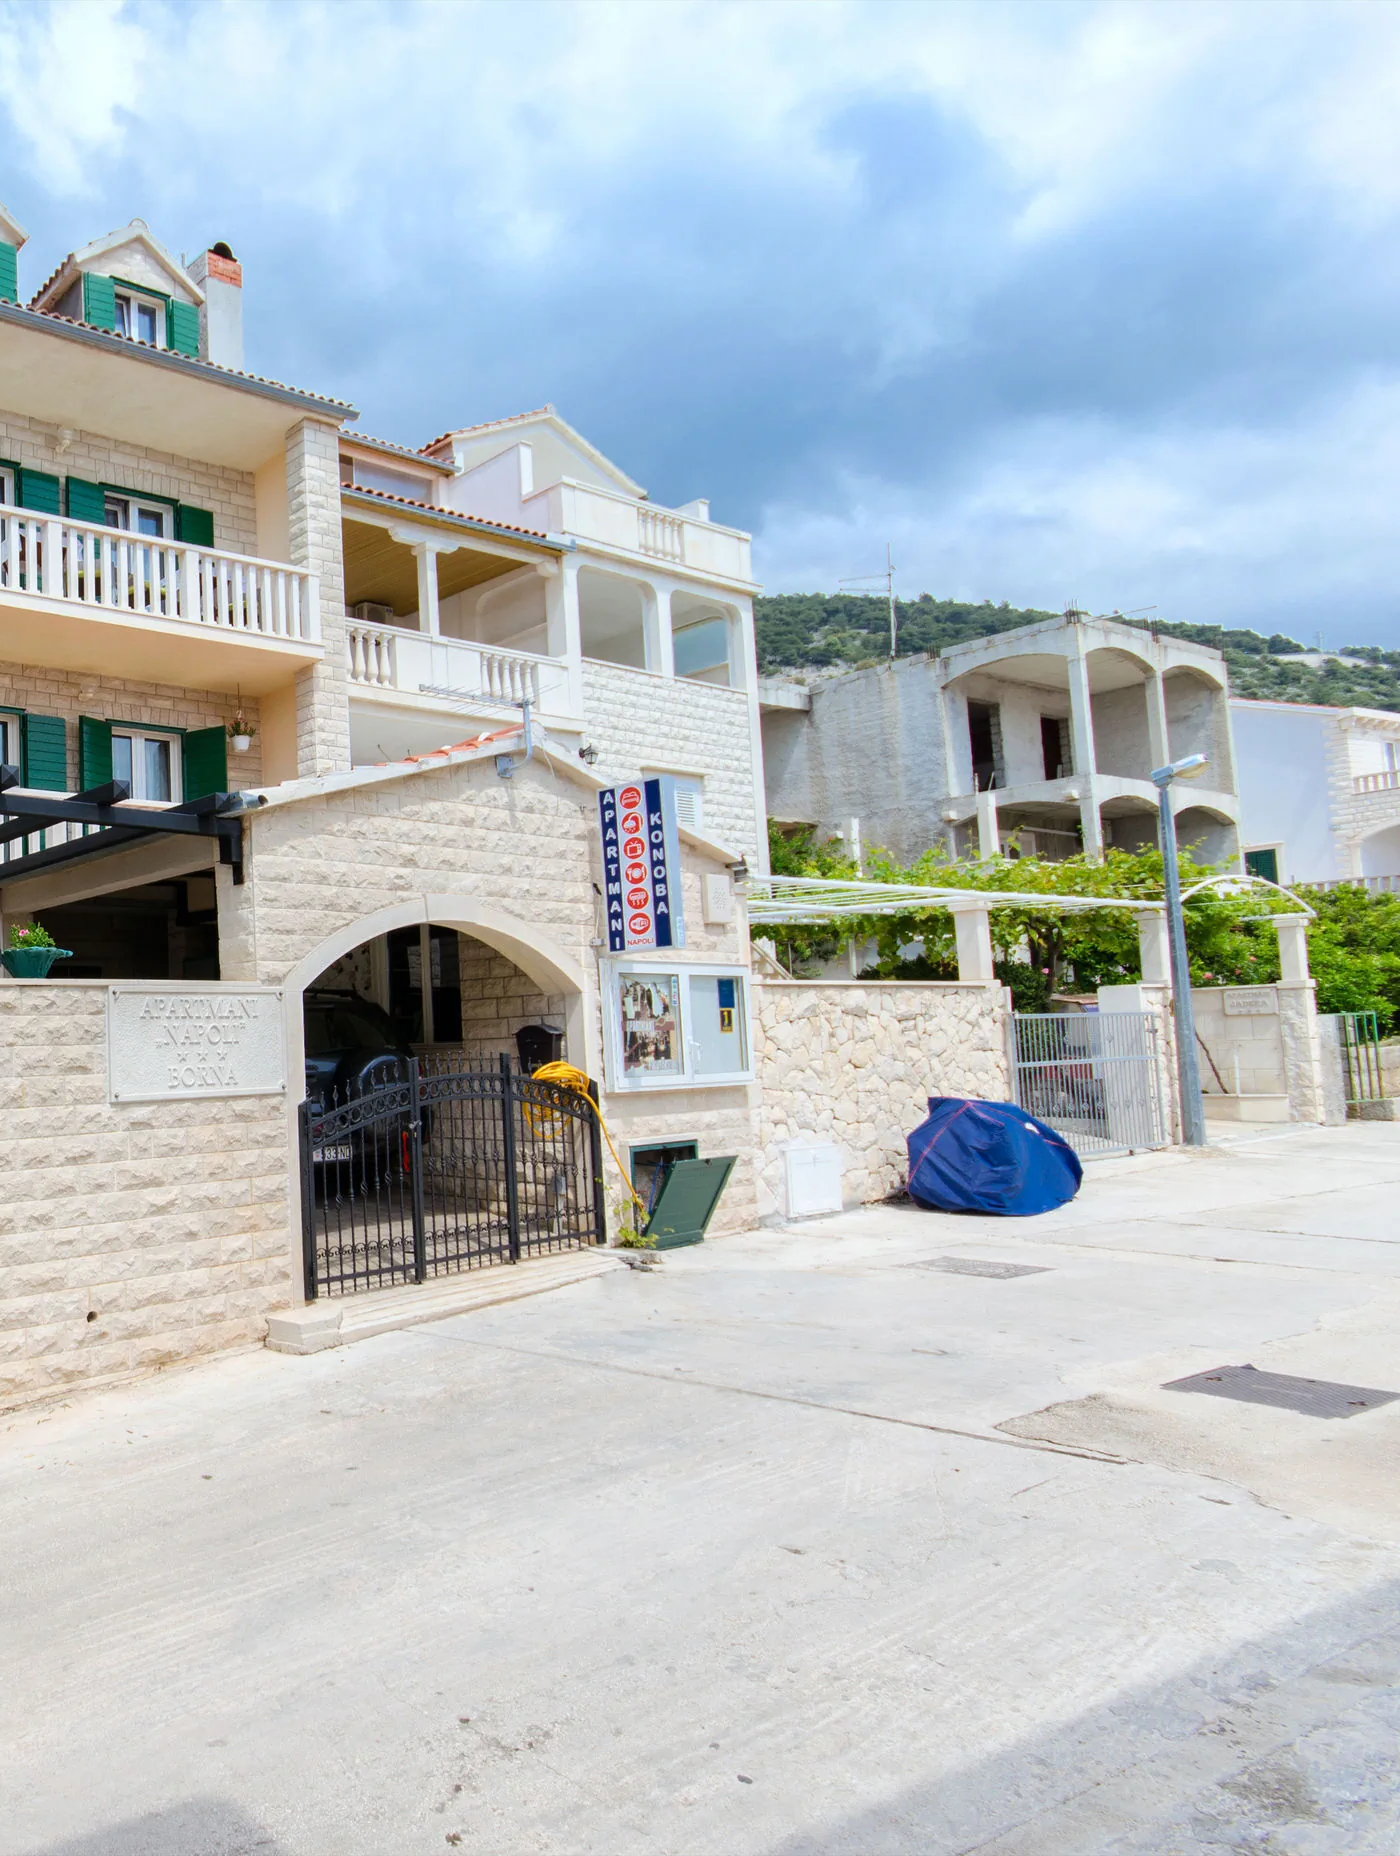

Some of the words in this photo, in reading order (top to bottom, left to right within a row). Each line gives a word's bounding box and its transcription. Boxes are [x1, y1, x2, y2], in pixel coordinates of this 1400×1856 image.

[602, 791, 623, 950] APARTMANI
[649, 811, 669, 916] KONOBA
[627, 937, 655, 946] NAPOLI
[139, 998, 260, 1020] APARTMANI
[167, 1065, 240, 1089] BORNA
